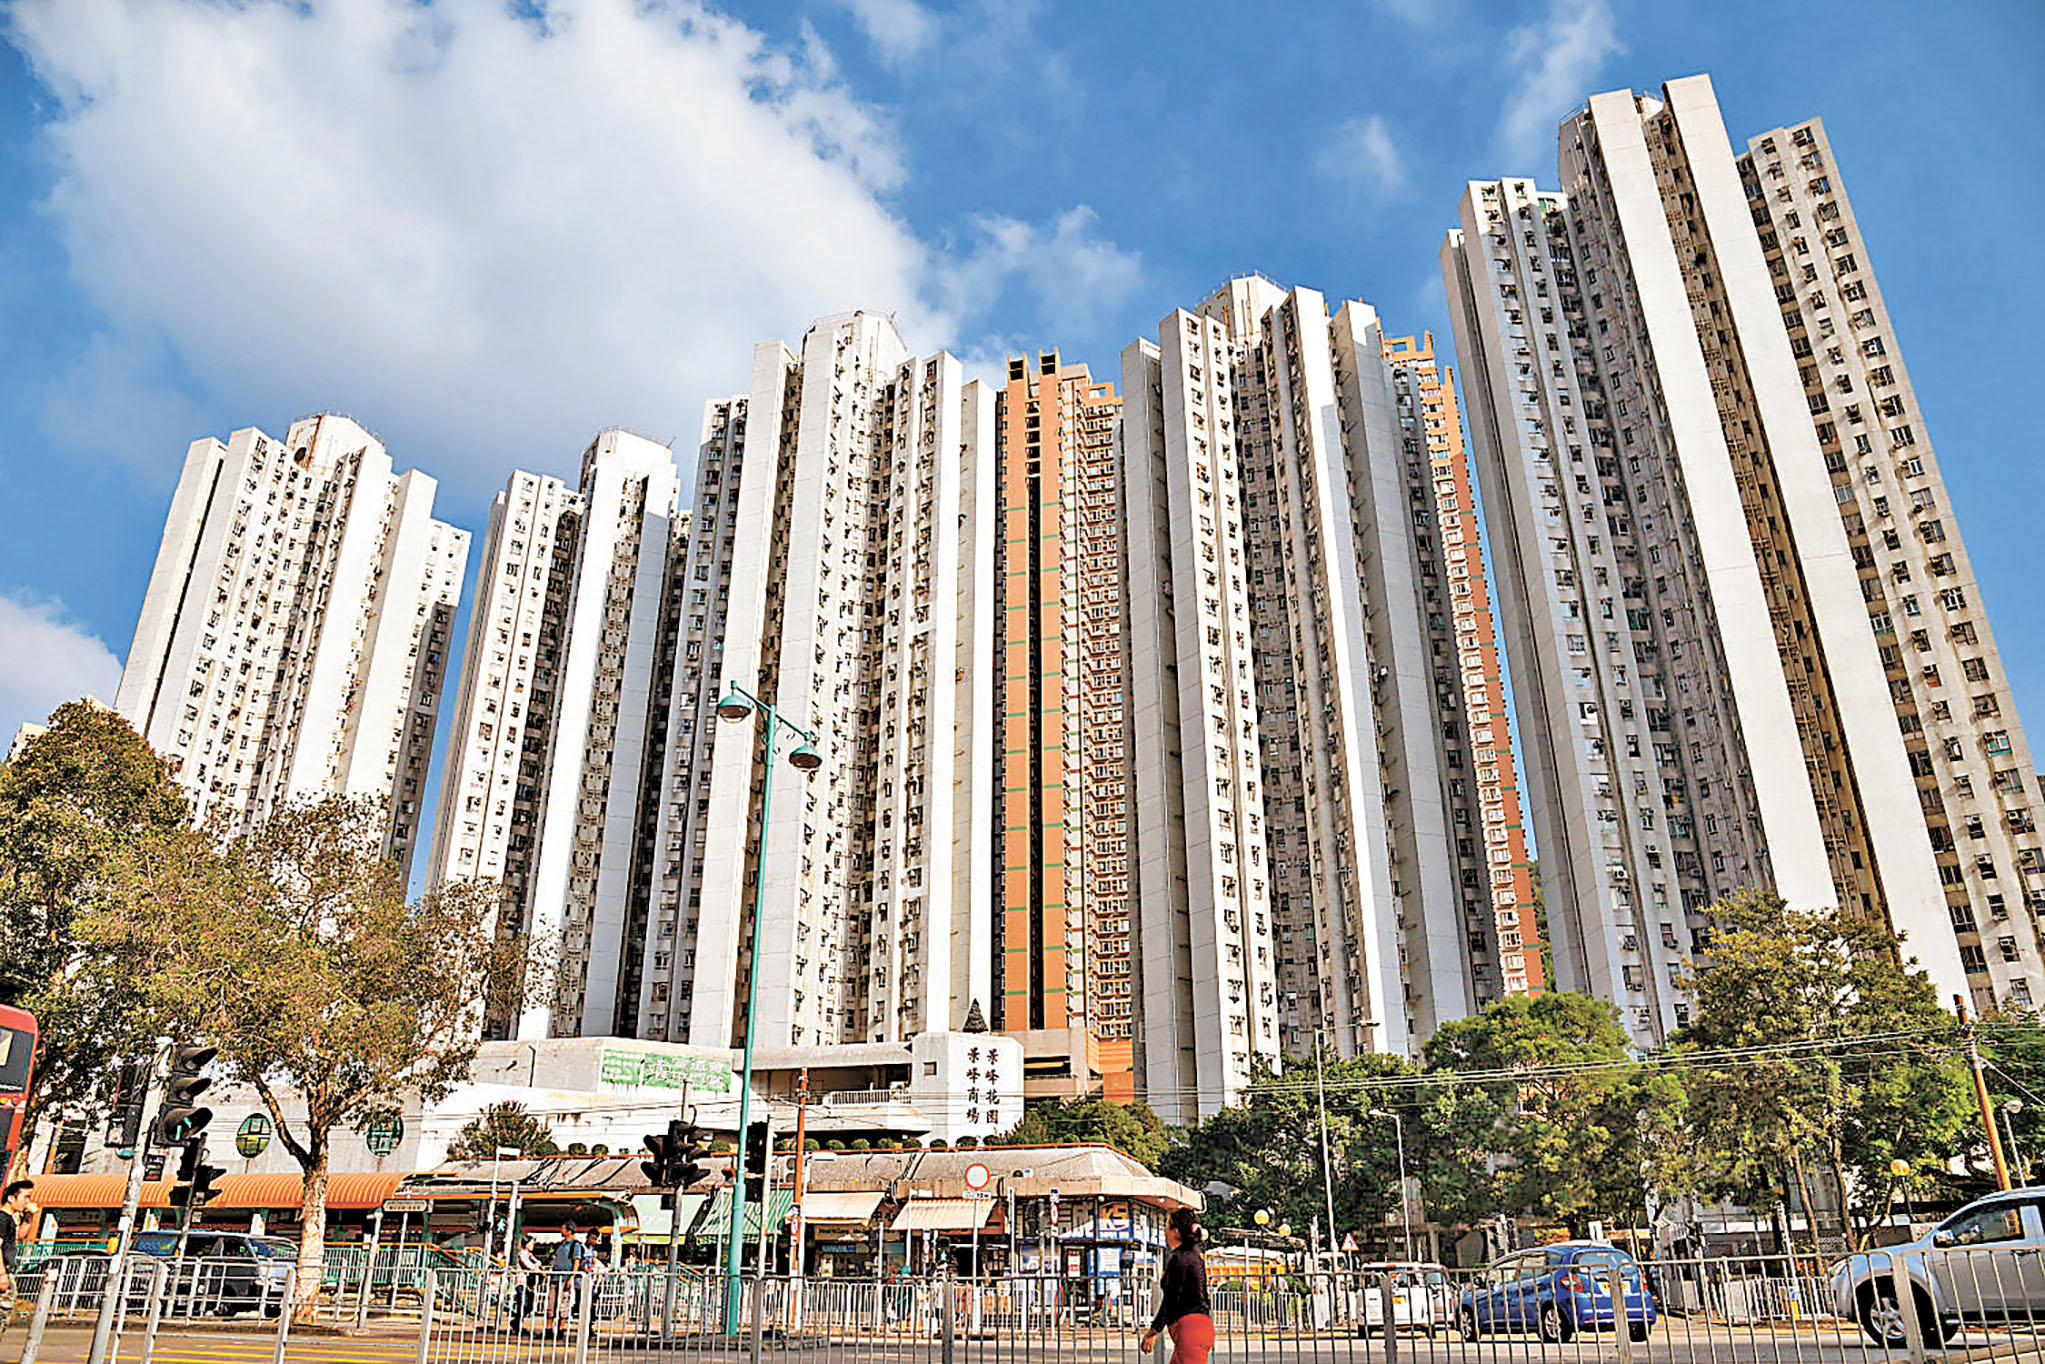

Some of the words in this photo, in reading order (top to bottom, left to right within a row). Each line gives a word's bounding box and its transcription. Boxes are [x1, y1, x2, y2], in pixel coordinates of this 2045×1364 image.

[966, 1046, 981, 1124] 景峰商場
[985, 1048, 1000, 1124] 景峰花園
